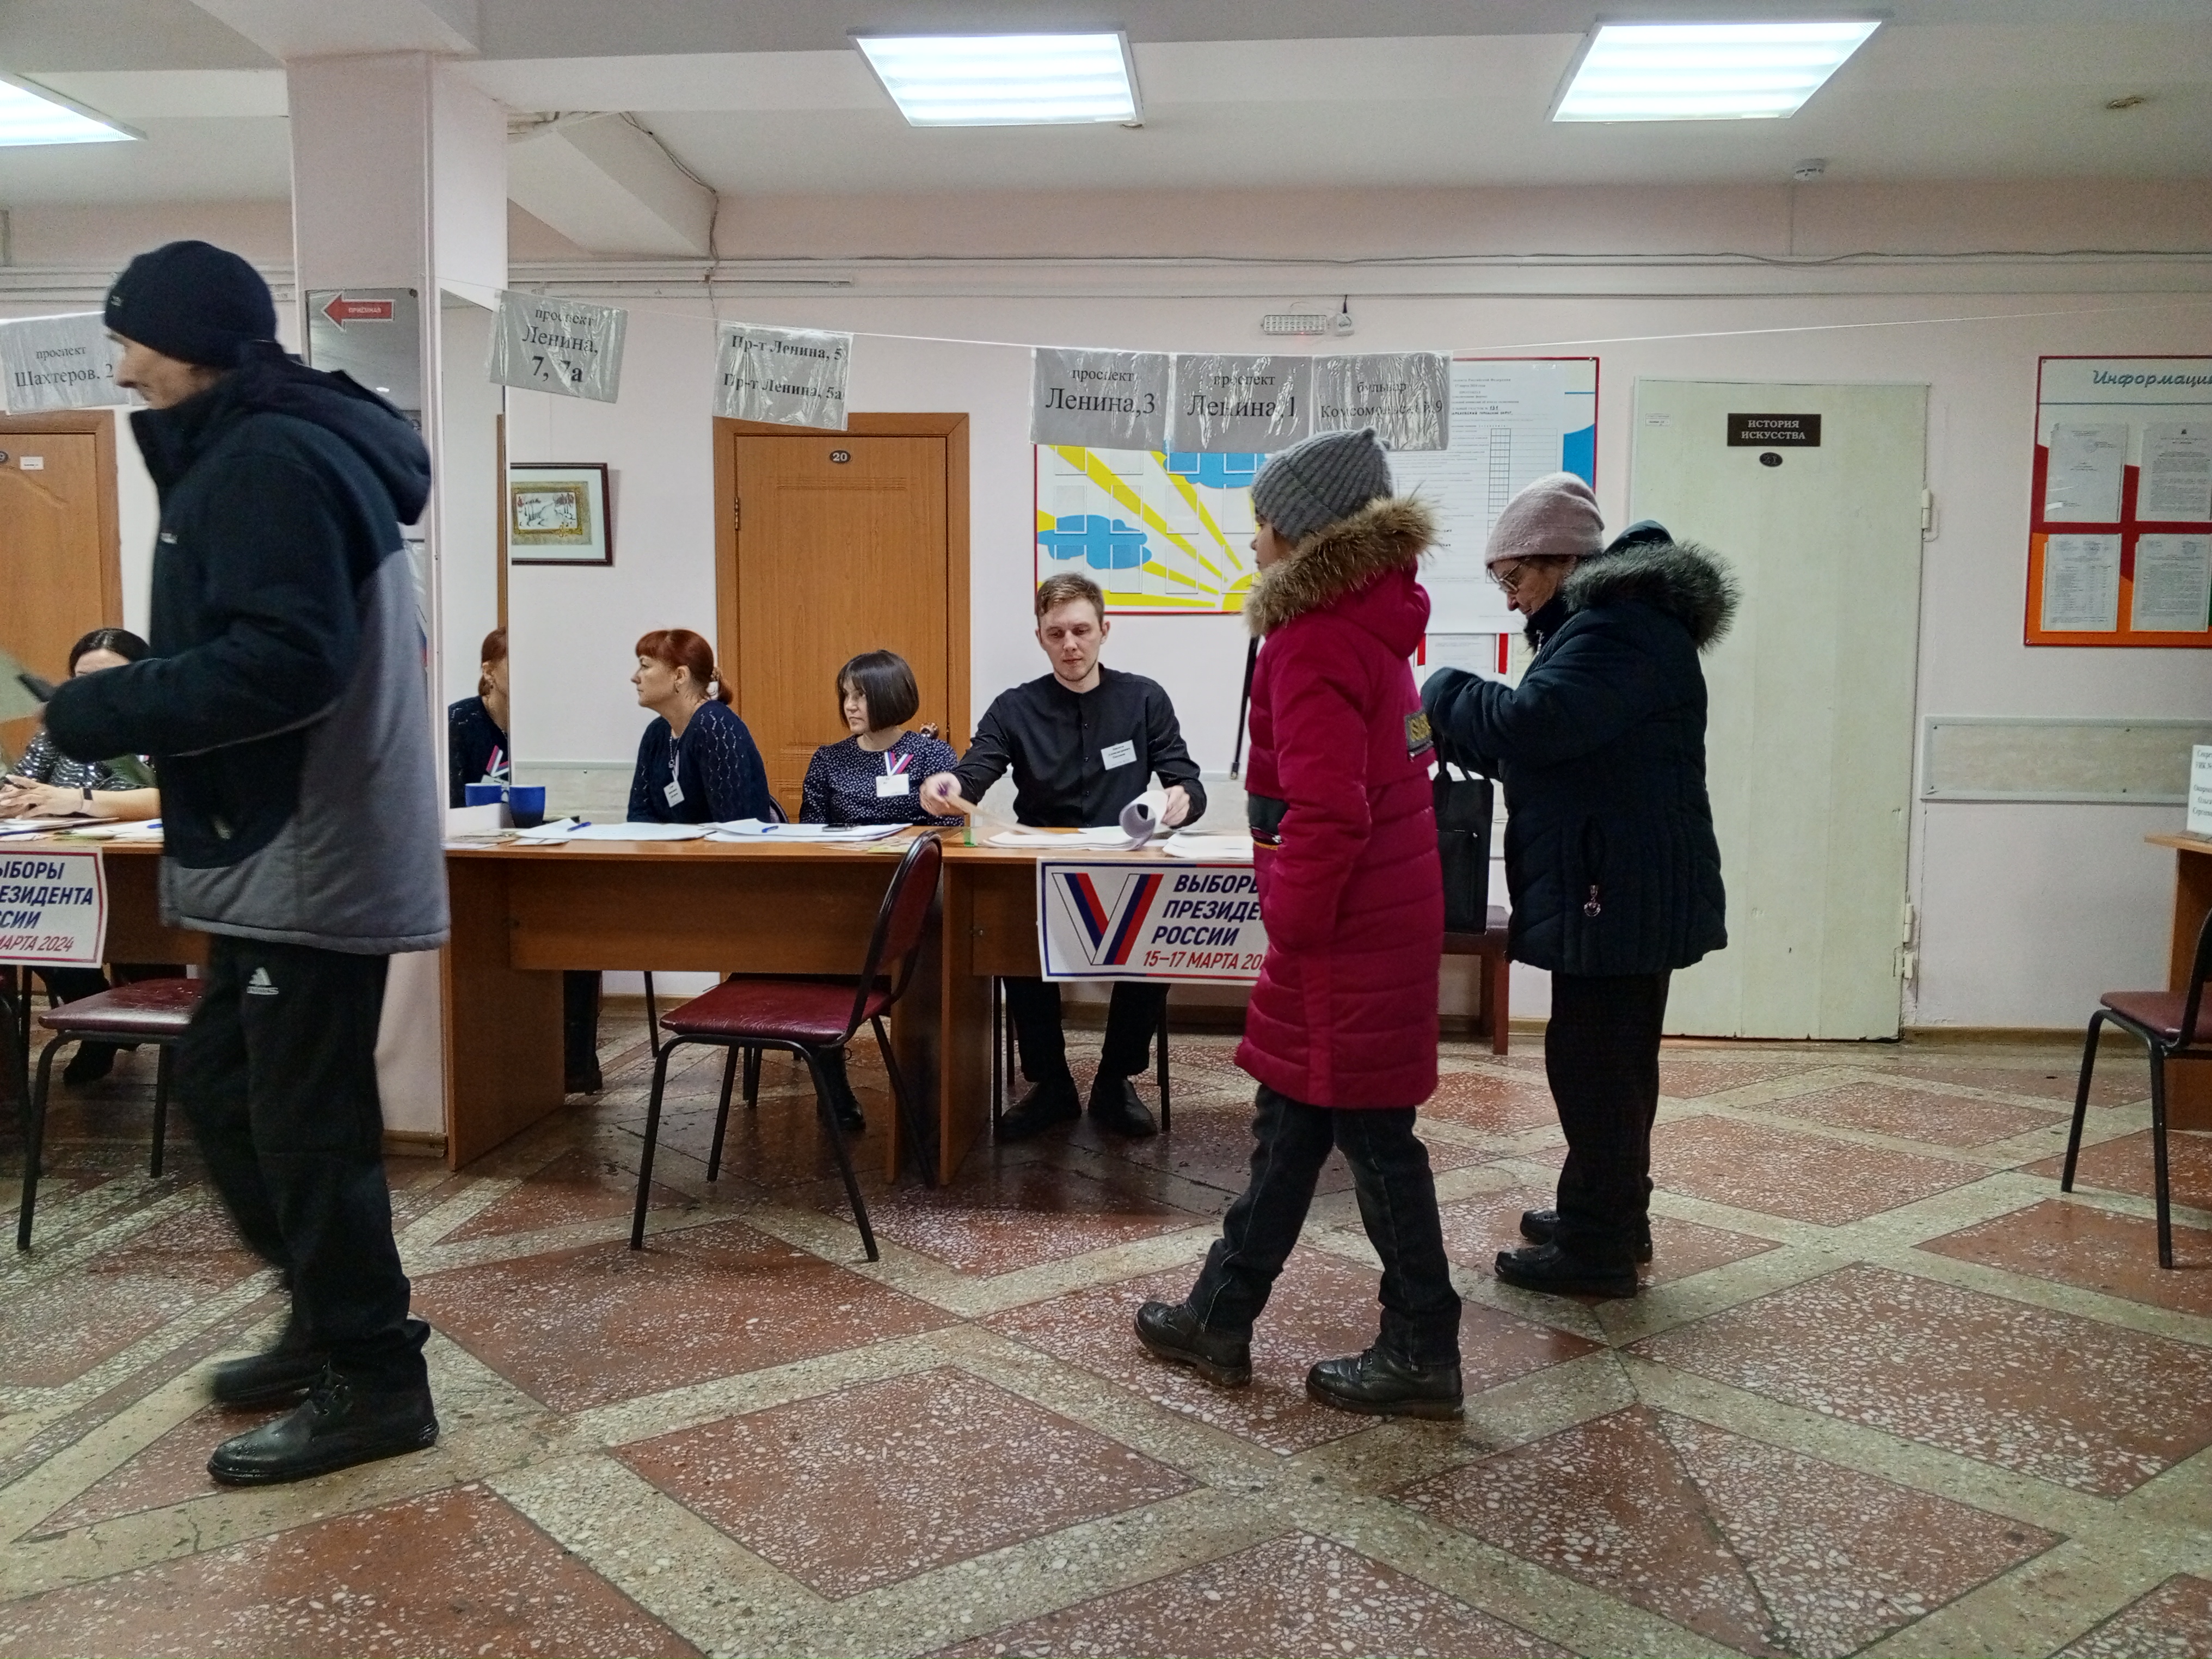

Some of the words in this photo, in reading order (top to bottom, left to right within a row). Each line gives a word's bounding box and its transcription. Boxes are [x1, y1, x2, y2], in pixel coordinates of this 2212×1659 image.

[536, 309, 594, 326] проспект
[522, 325, 598, 356] Ленина,
[732, 335, 766, 352] Пр-т
[770, 340, 830, 360] Ленина,
[834, 348, 843, 360] 5
[36, 347, 86, 360] проспект
[1072, 370, 1134, 382] проспект
[1213, 376, 1276, 388] проспект
[762, 379, 821, 399] Ленина,
[1741, 431, 1805, 439] ИСКУССТВА
[833, 452, 847, 462] 20
[0, 910, 42, 929] СИИ
[1162, 900, 1263, 923] ПРЕЗИДЕ
[37, 936, 74, 952] 2024
[1151, 925, 1240, 946] РОССИИ
[1187, 951, 1240, 969] МАРТА
[1241, 953, 1264, 970] 20
